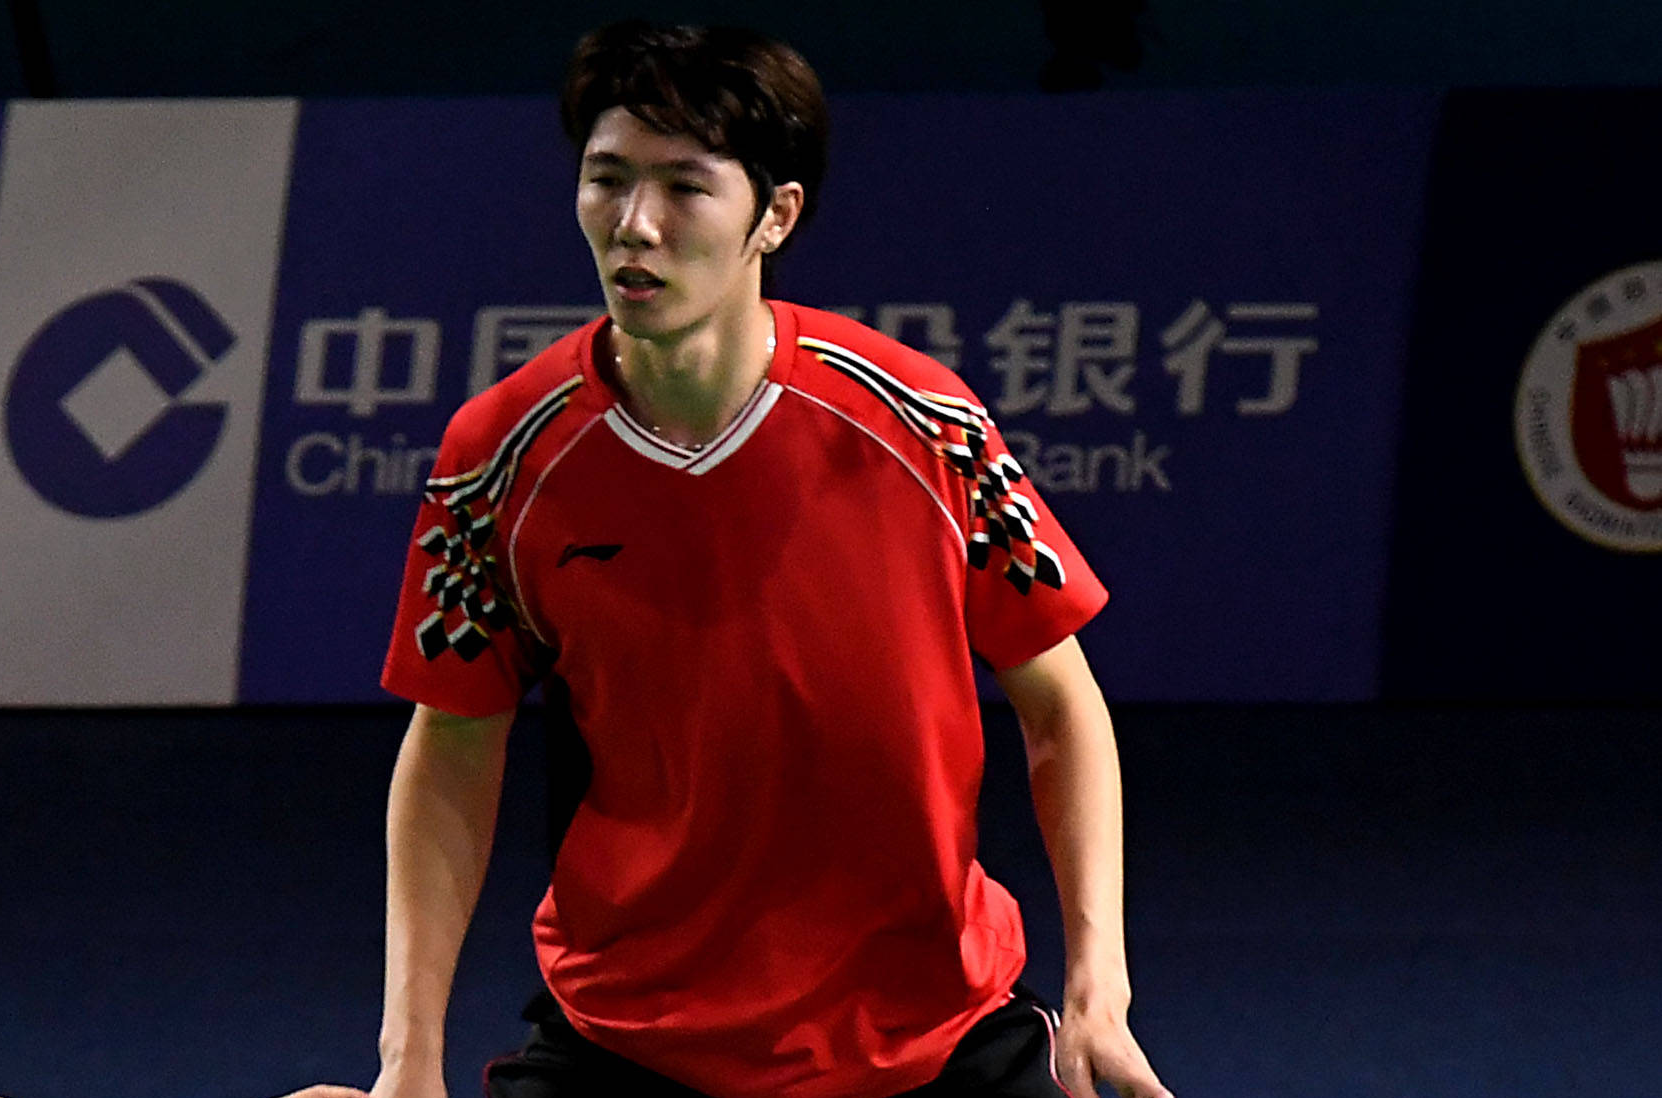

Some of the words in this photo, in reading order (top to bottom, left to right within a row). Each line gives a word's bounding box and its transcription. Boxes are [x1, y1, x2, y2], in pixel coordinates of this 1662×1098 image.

[294, 298, 1318, 420] 中银行
[286, 432, 438, 496] Chin
